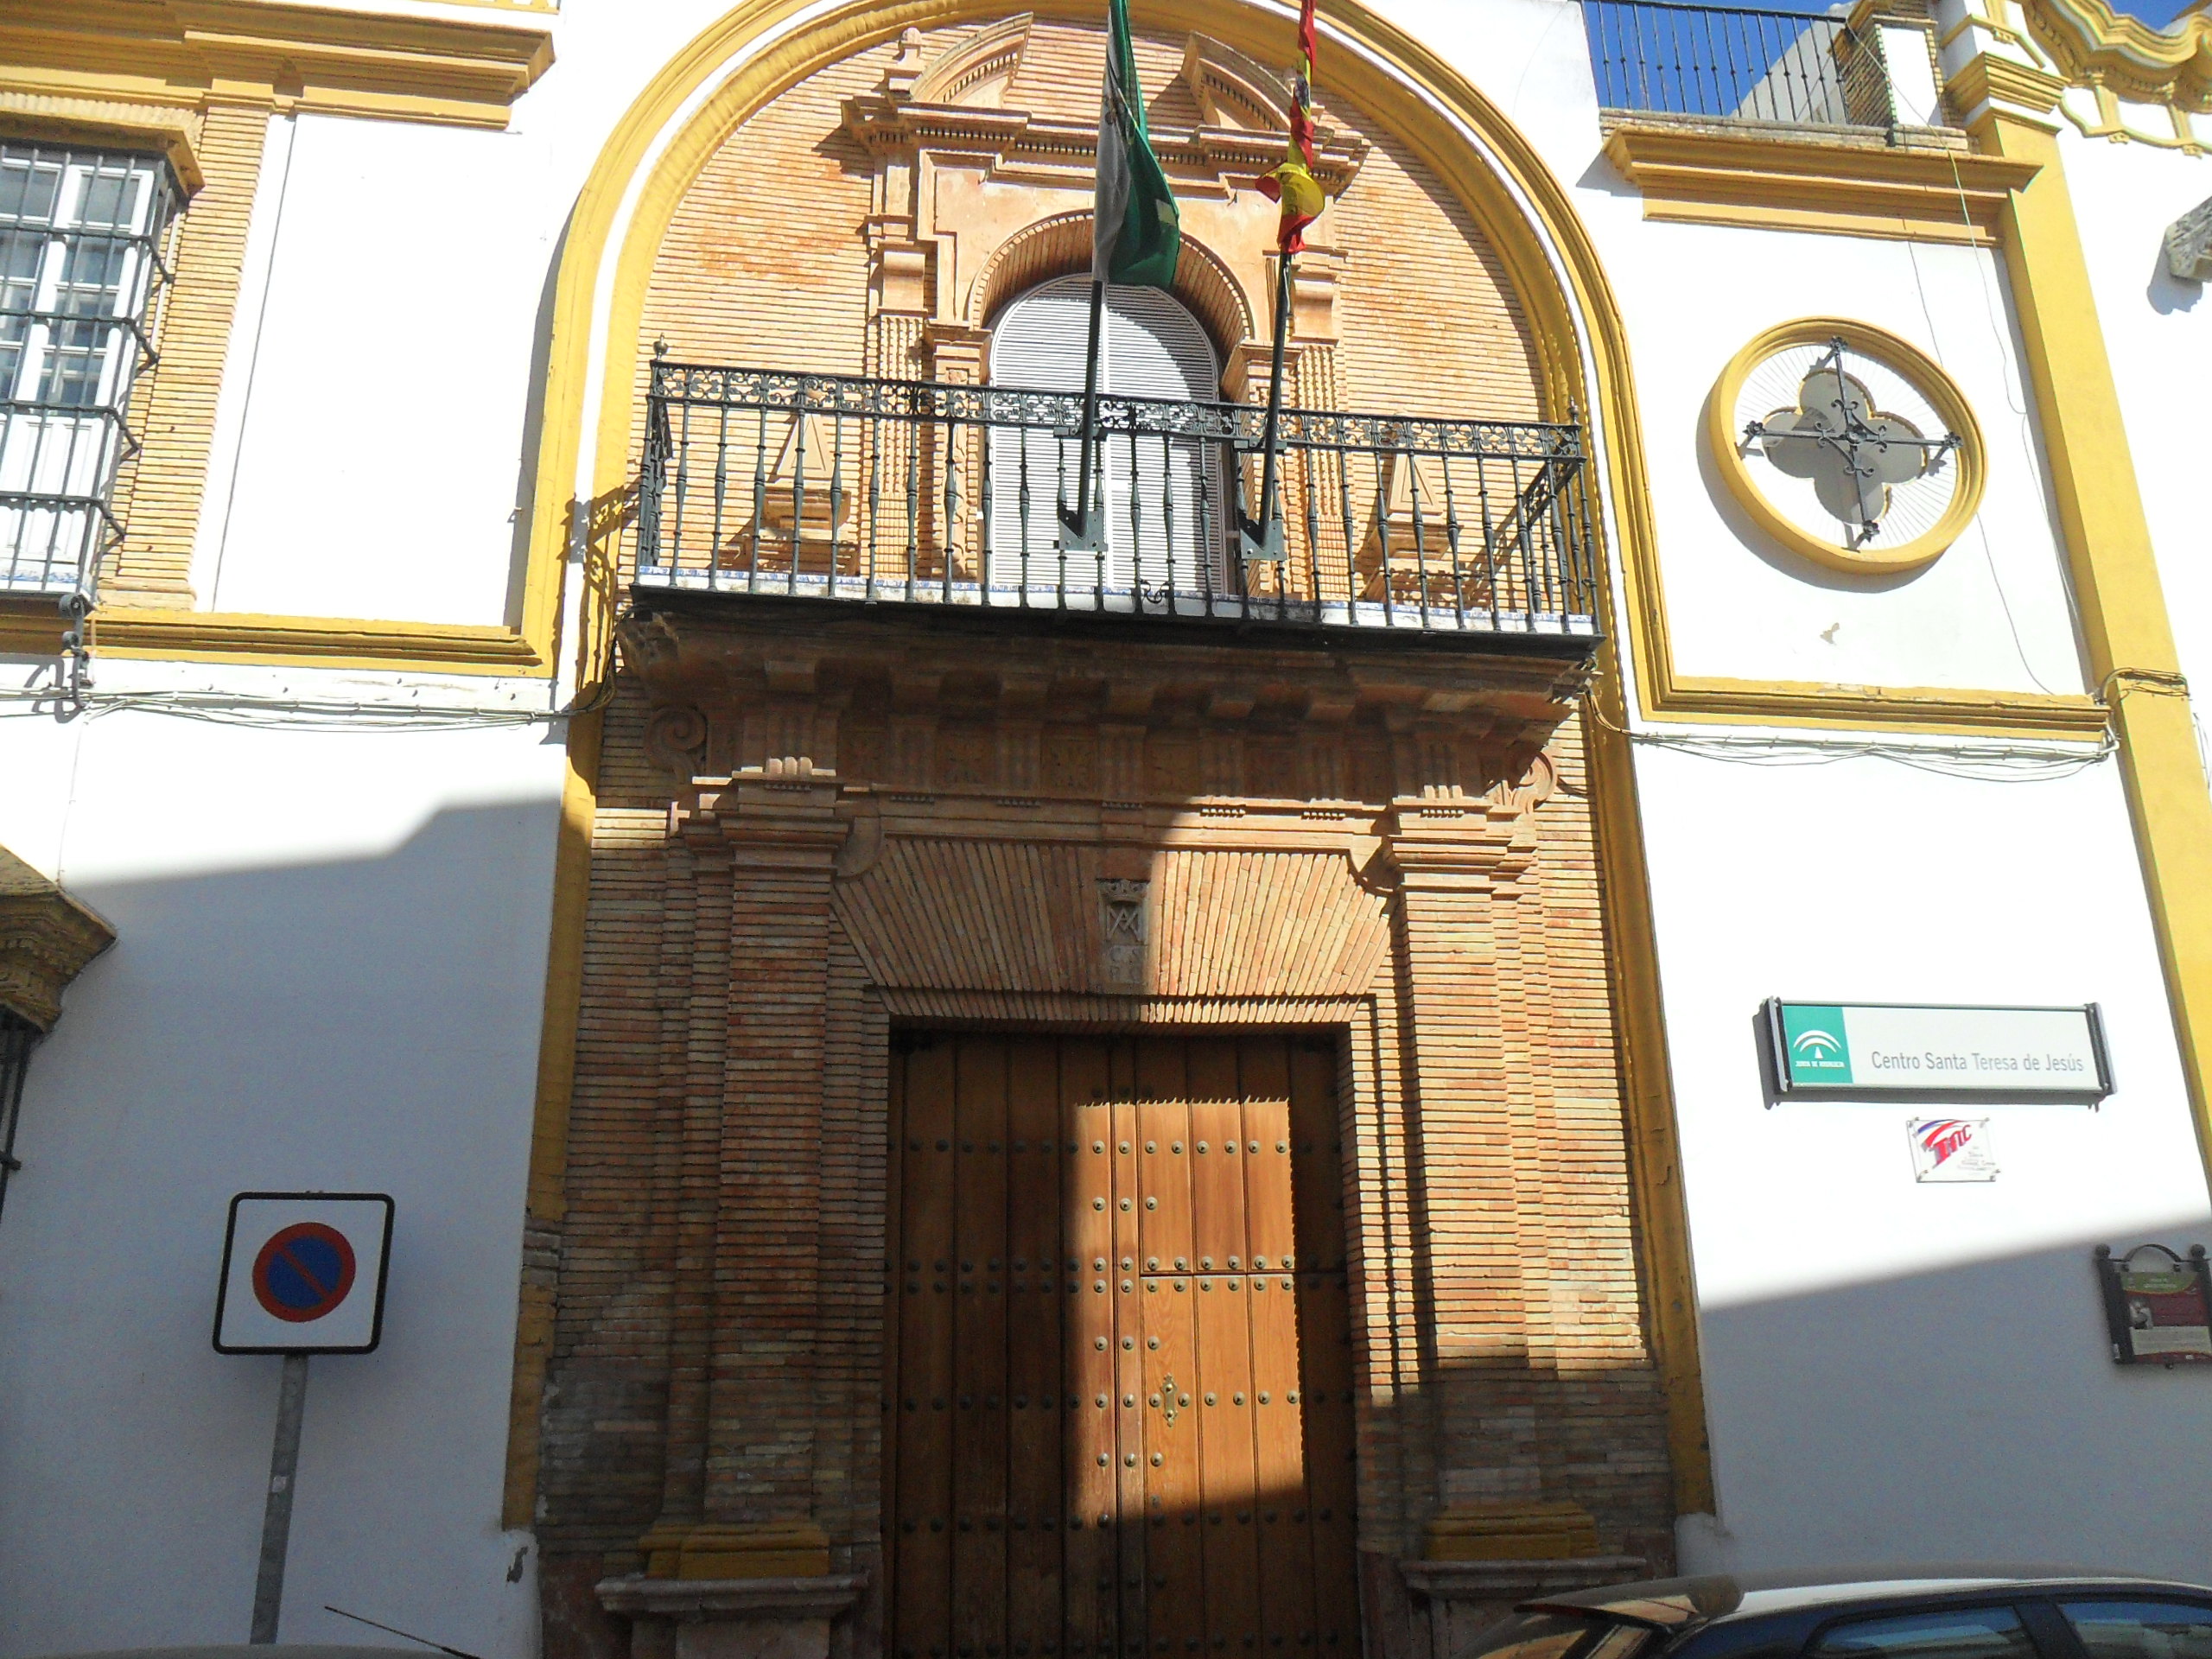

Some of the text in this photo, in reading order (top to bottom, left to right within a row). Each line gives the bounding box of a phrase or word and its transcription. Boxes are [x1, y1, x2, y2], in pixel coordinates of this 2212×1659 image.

[1872, 1051, 2083, 1072] Centro Santa Teresa de Jesús
